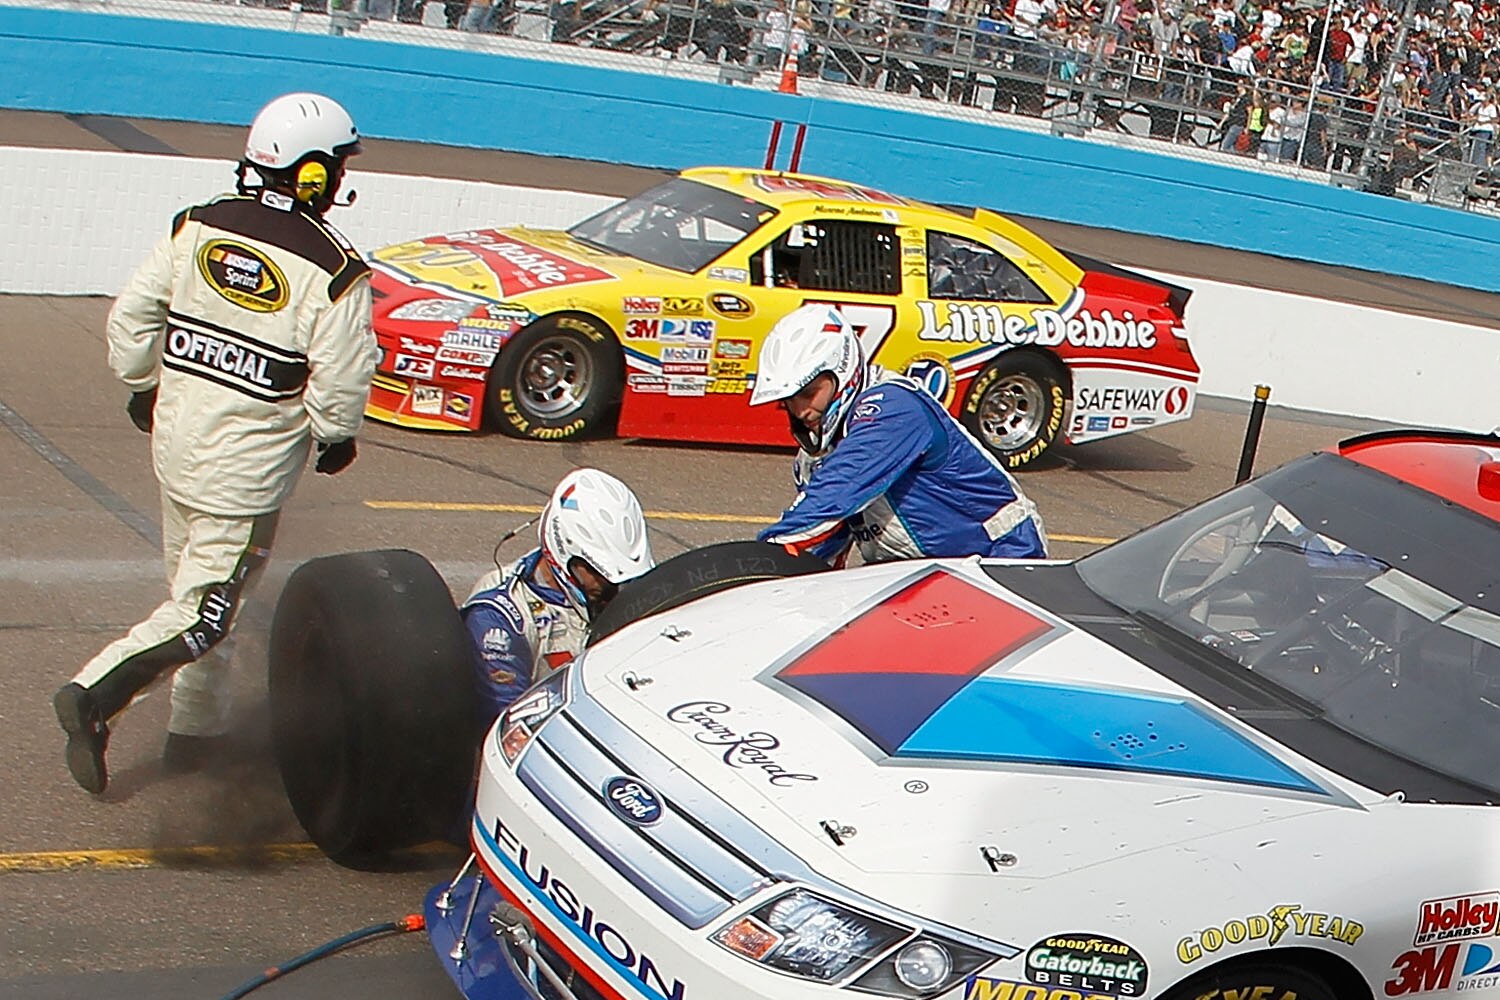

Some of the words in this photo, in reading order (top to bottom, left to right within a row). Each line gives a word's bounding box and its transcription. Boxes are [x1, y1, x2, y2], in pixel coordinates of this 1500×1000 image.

[224, 267, 260, 290] Sprint
[445, 331, 501, 349] MAHLE
[625, 319, 659, 339] 3M
[918, 301, 1028, 344] Little
[1031, 308, 1157, 349] Debbie
[168, 326, 273, 388] OFFICIAL
[708, 380, 747, 394] JEGS
[904, 360, 948, 400] 50
[1075, 387, 1165, 413] SAFEWAY
[666, 699, 731, 743] Crown
[721, 732, 819, 789] Royal
[609, 780, 657, 820] Ford
[1420, 897, 1500, 935] Holley
[1416, 932, 1437, 945] HP
[1437, 926, 1482, 942] CARBS
[1028, 951, 1145, 984] Gatorback
[1034, 971, 1136, 996] BELTS
[1384, 943, 1462, 999] 3M
